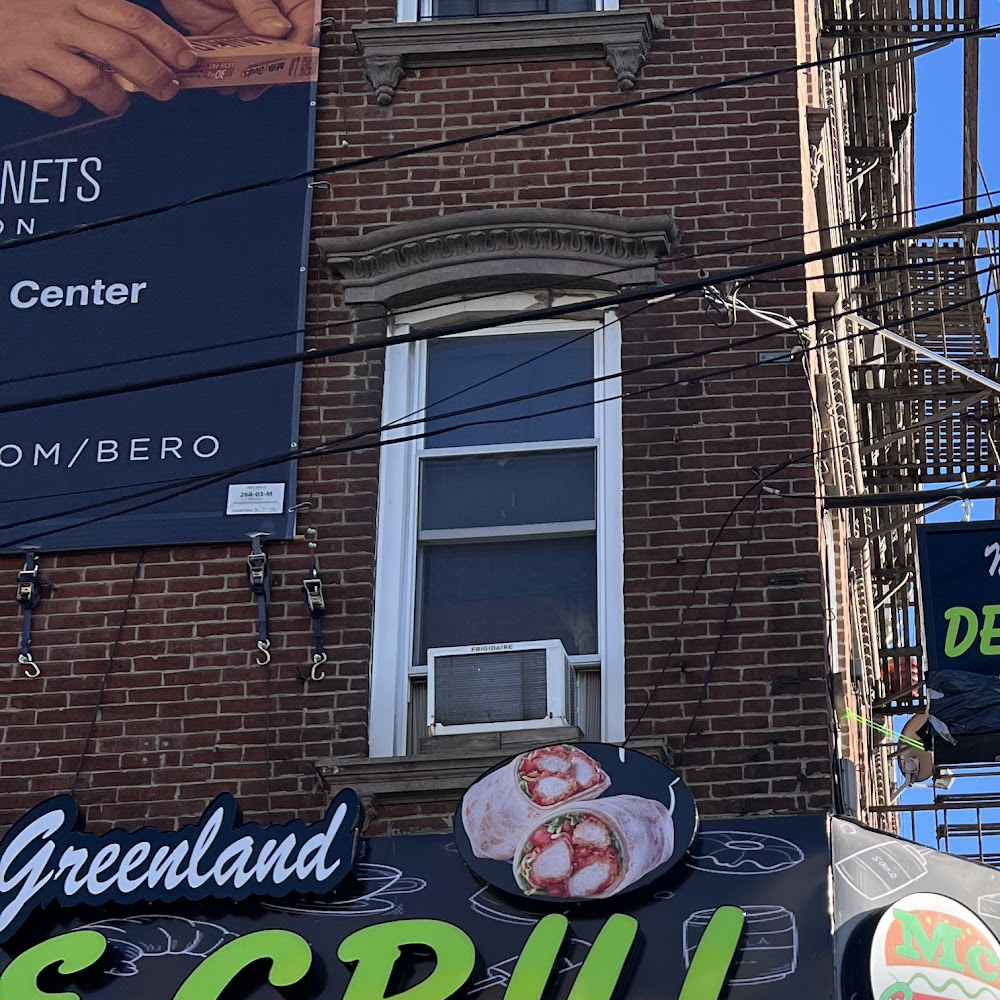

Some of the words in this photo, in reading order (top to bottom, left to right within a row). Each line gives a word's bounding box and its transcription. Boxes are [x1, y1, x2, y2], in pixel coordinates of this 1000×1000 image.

[0, 156, 102, 205] NETS
[9, 278, 148, 309] Center
[0, 435, 220, 468] OM/BERO
[471, 643, 513, 653] FRIGIDAIRE
[0, 801, 348, 931] Greenland
[892, 907, 1000, 983] Mc
